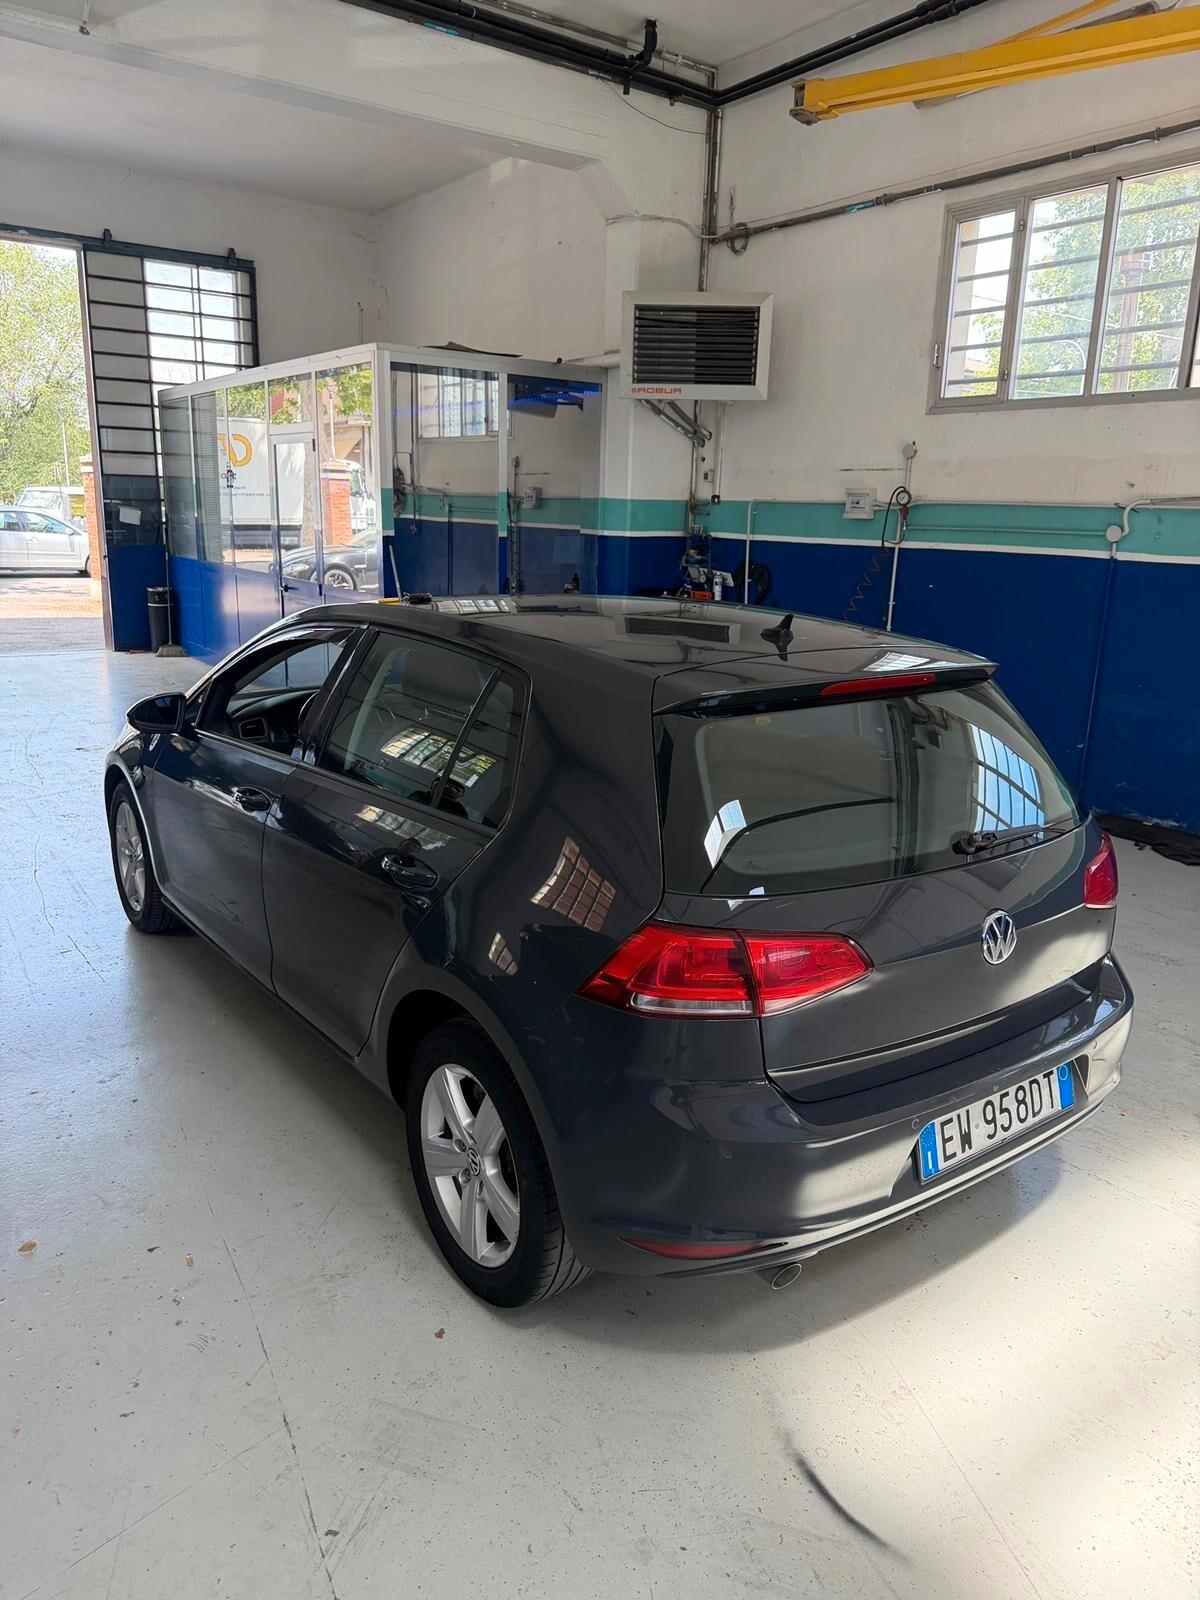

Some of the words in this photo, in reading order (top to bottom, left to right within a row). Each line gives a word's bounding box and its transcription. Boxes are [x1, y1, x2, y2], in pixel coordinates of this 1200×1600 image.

[983, 911, 1017, 964] VW
[940, 1109, 973, 1163] EW
[982, 1070, 1055, 1140] 958DT
